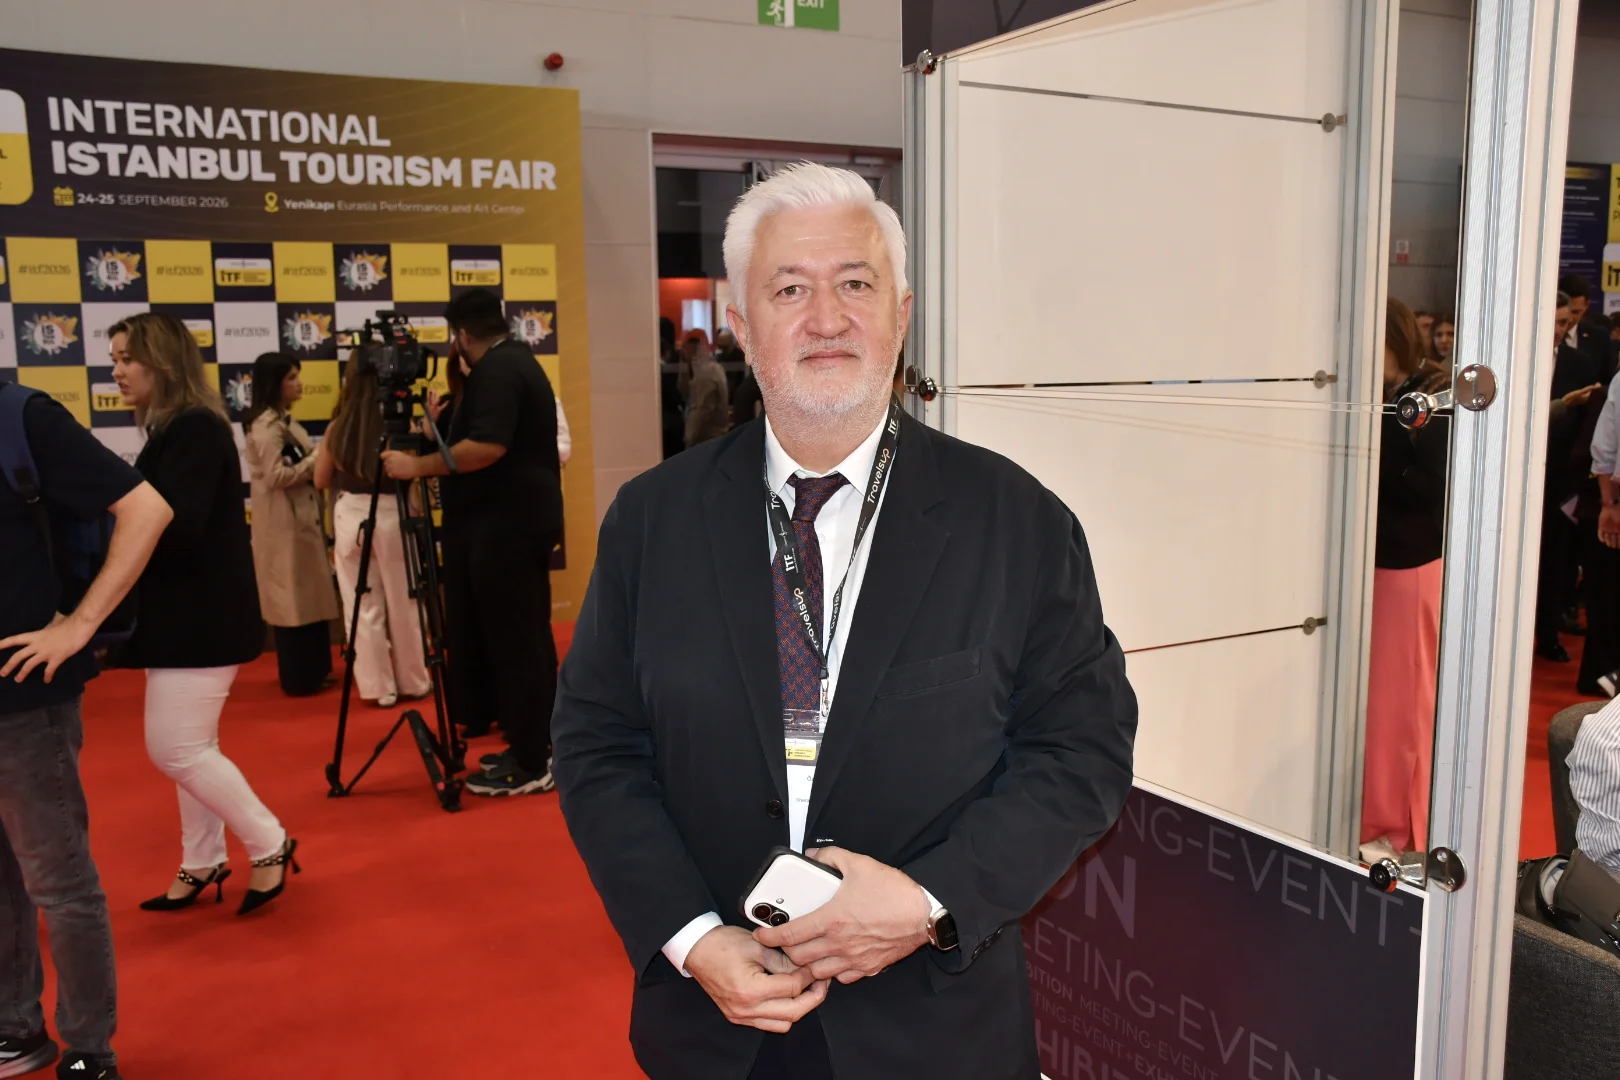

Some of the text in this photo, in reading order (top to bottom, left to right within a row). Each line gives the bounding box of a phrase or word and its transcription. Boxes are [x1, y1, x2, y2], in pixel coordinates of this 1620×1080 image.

[47, 96, 390, 148] INTERNATIONAL
[51, 140, 557, 190] ISTANBUL TOURISM FAIR
[77, 193, 229, 208] 24-25 SEPTEMBER 2026
[337, 200, 378, 211] Eurasia
[380, 200, 449, 213] Performance
[451, 202, 471, 213] and
[19, 264, 71, 275] #itf2026
[784, 554, 795, 572] ITF
